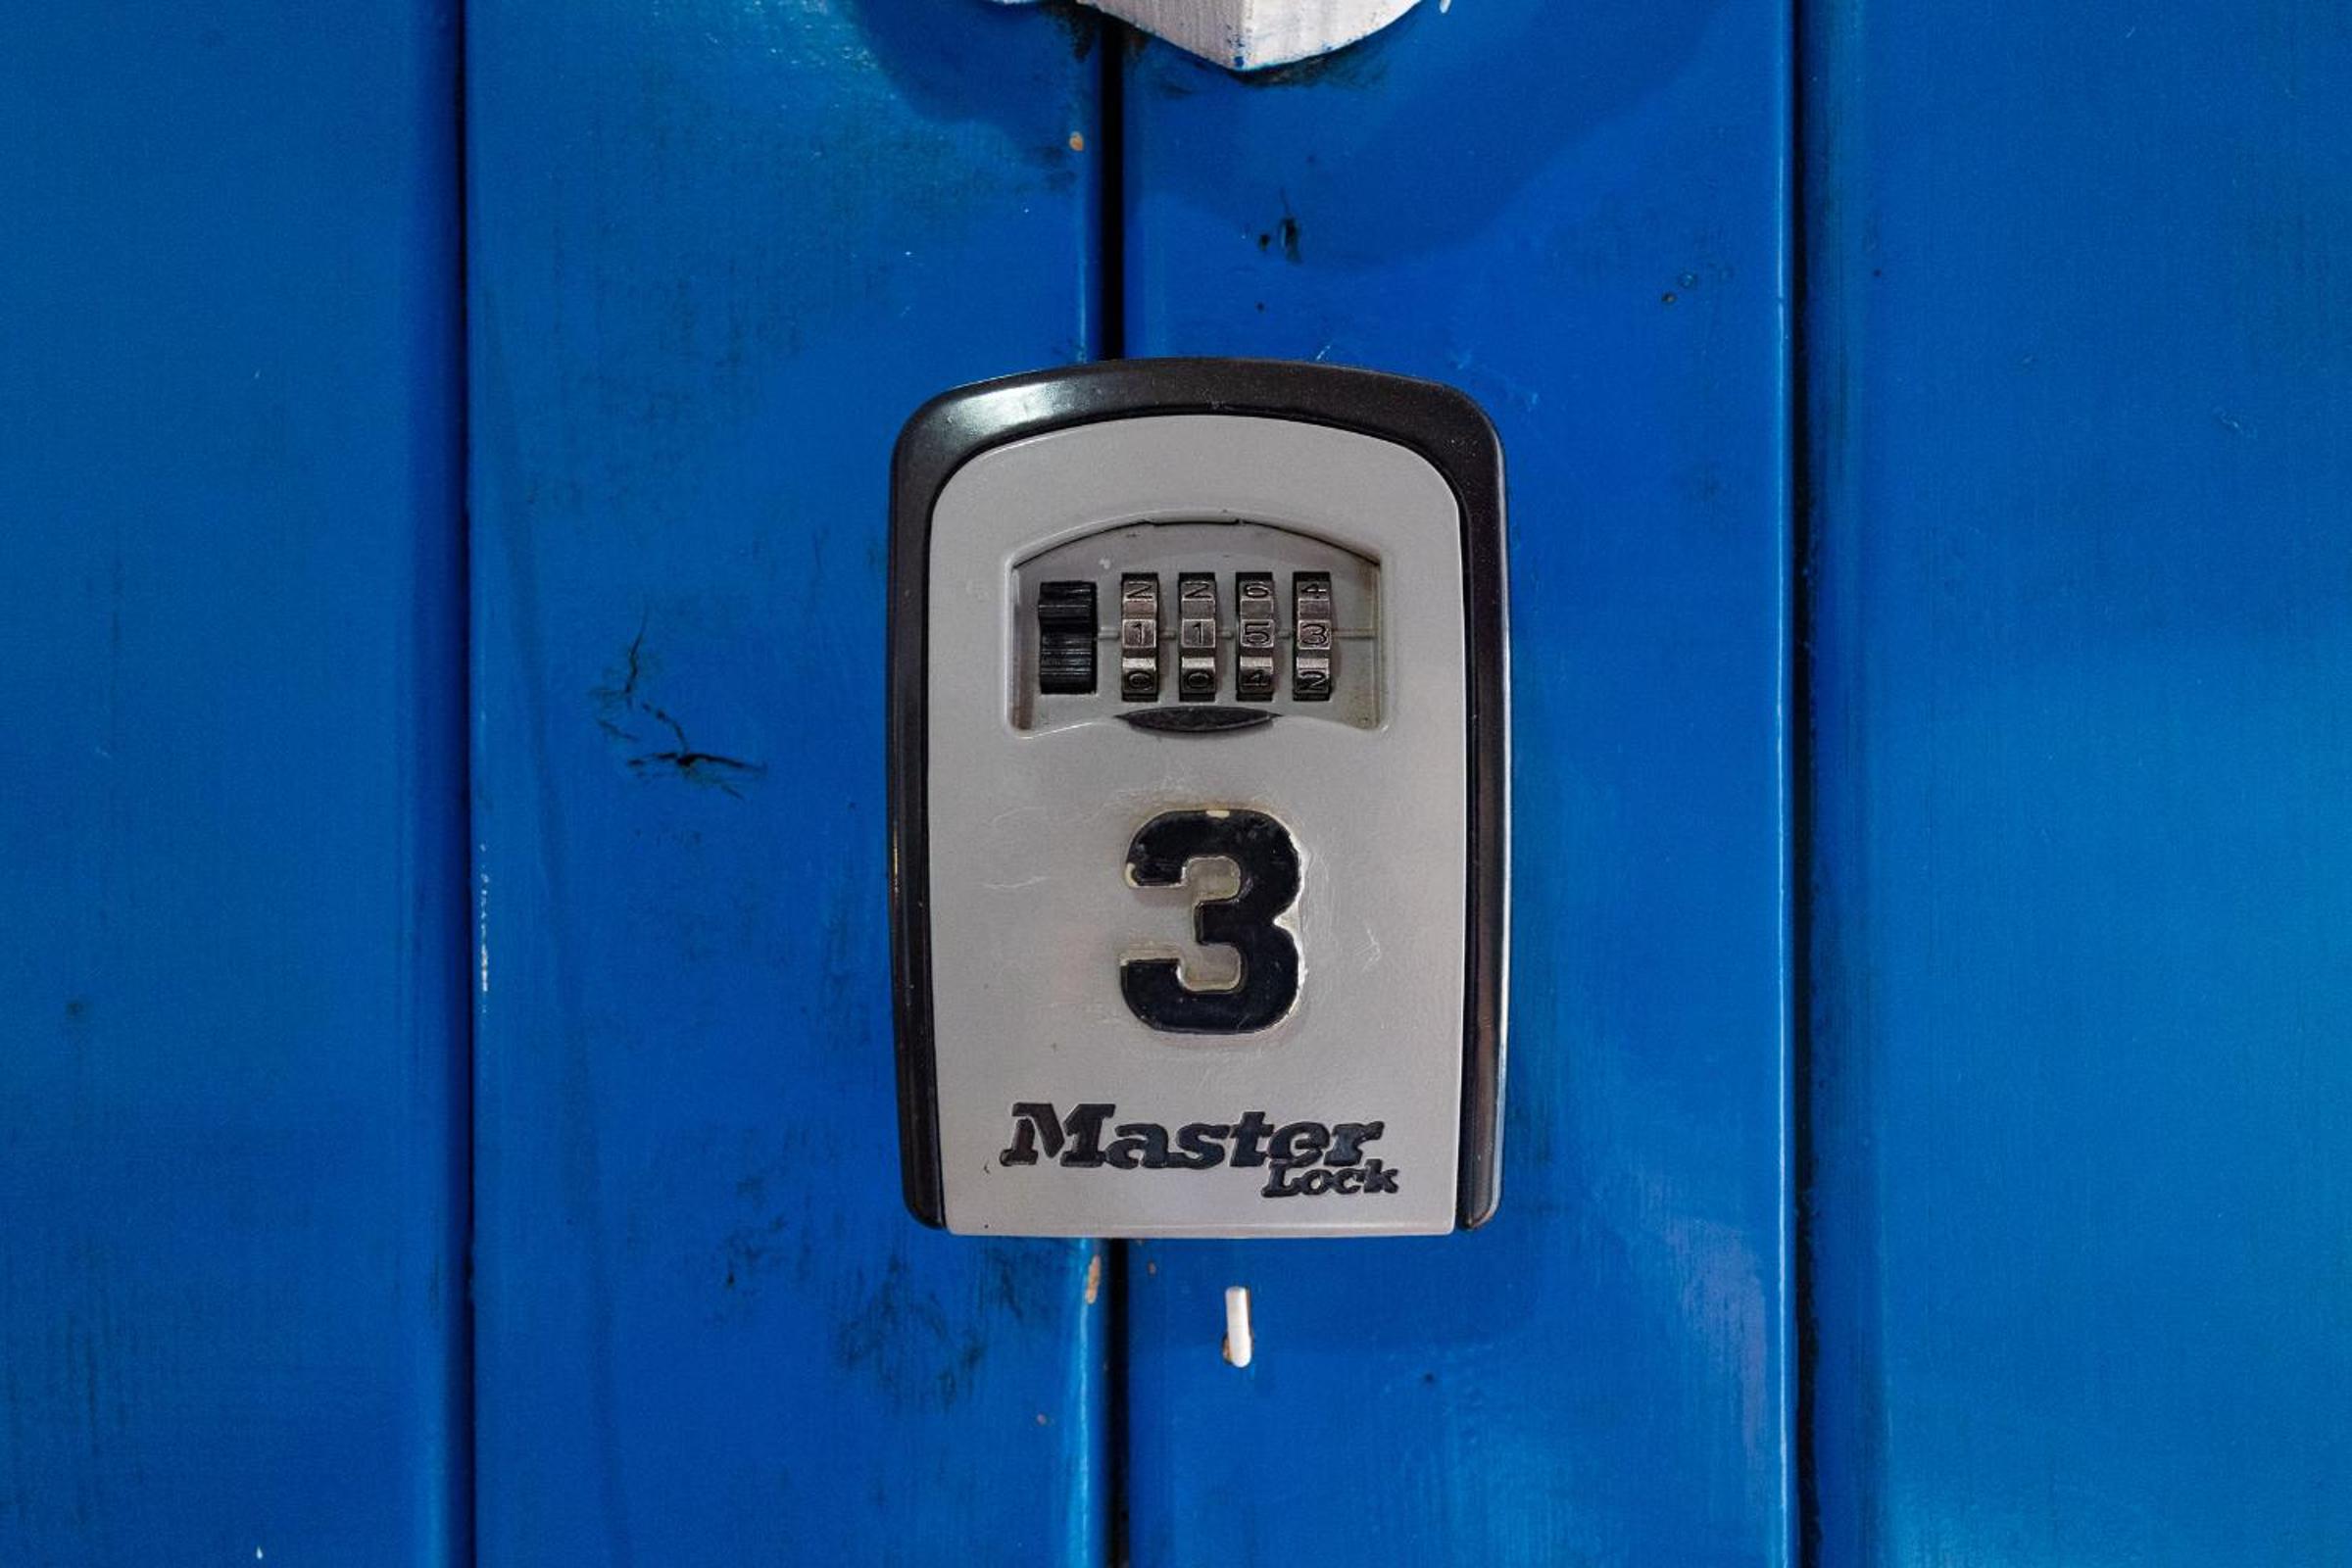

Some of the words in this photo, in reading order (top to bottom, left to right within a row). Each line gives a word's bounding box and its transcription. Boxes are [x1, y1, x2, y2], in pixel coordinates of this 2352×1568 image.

[1244, 621, 1271, 645] 5
[1299, 623, 1329, 646] 3
[1120, 808, 1301, 1035] 3
[999, 1102, 1386, 1170] Master
[1260, 1158, 1399, 1198] Lock
